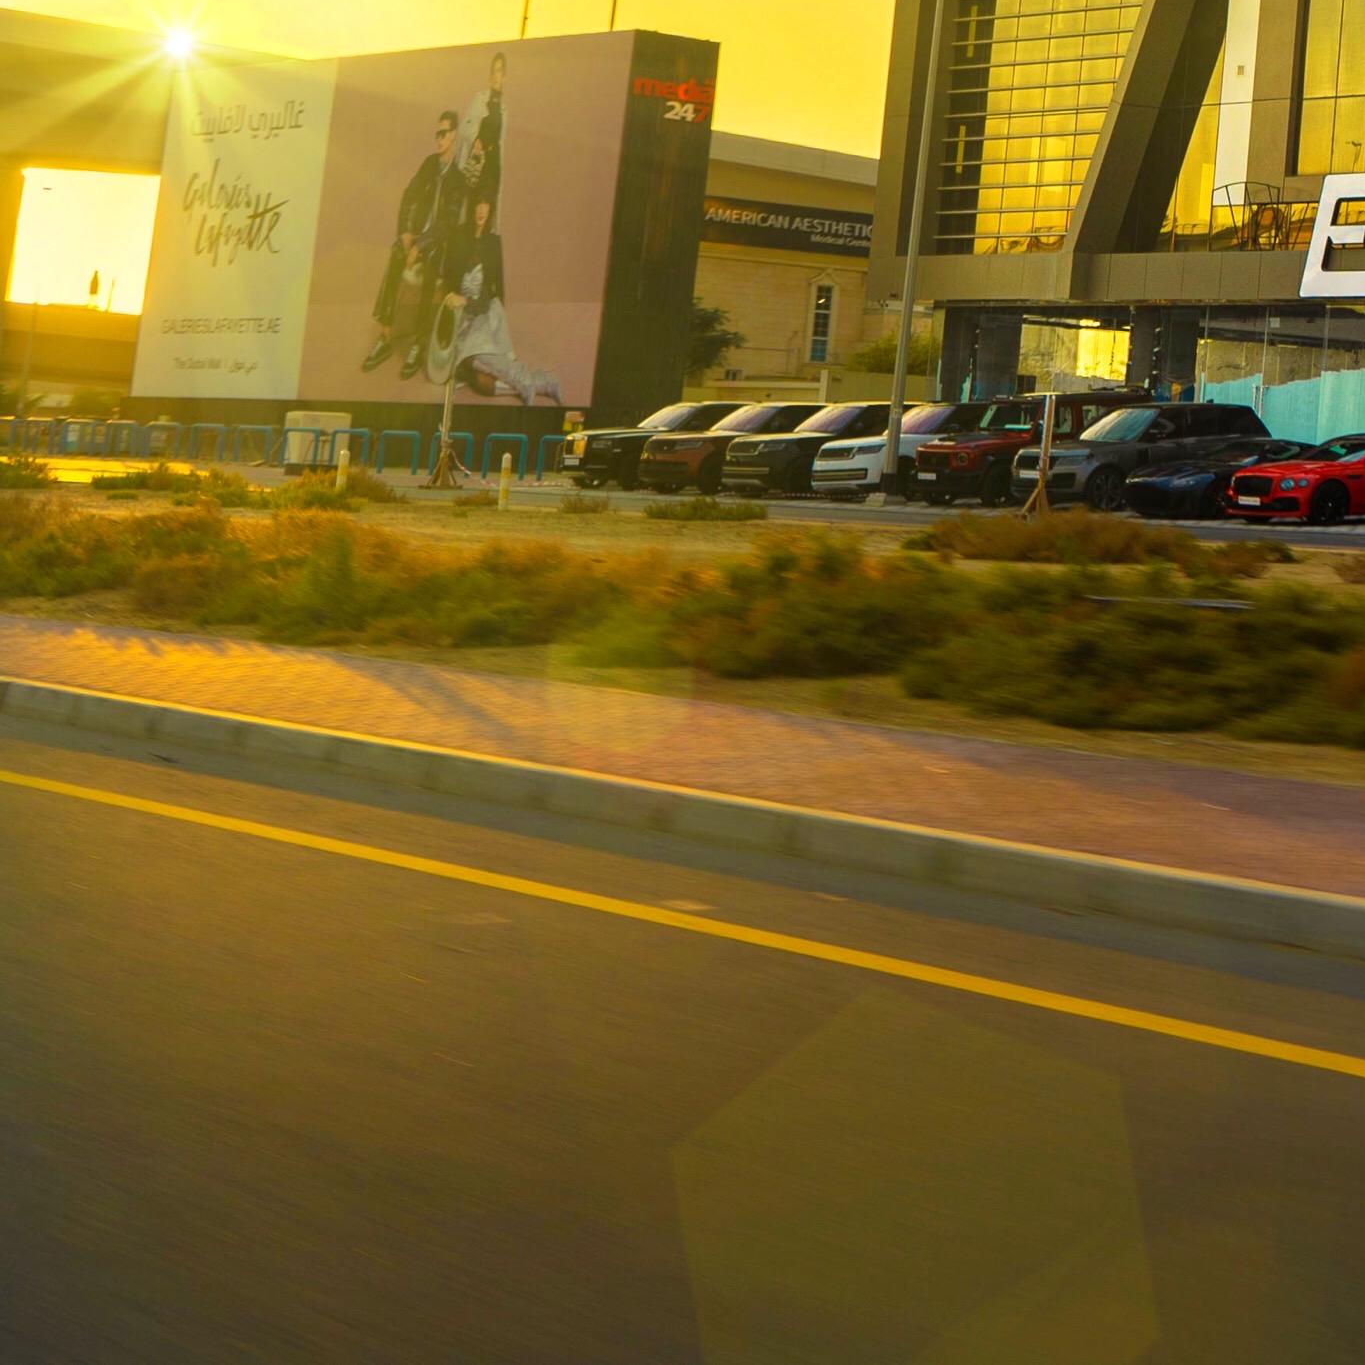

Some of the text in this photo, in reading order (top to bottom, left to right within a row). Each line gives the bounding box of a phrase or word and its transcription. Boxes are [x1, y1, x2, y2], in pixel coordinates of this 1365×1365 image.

[633, 76, 715, 104] media
[663, 100, 711, 123] 247
[704, 208, 790, 230] AMERICAN
